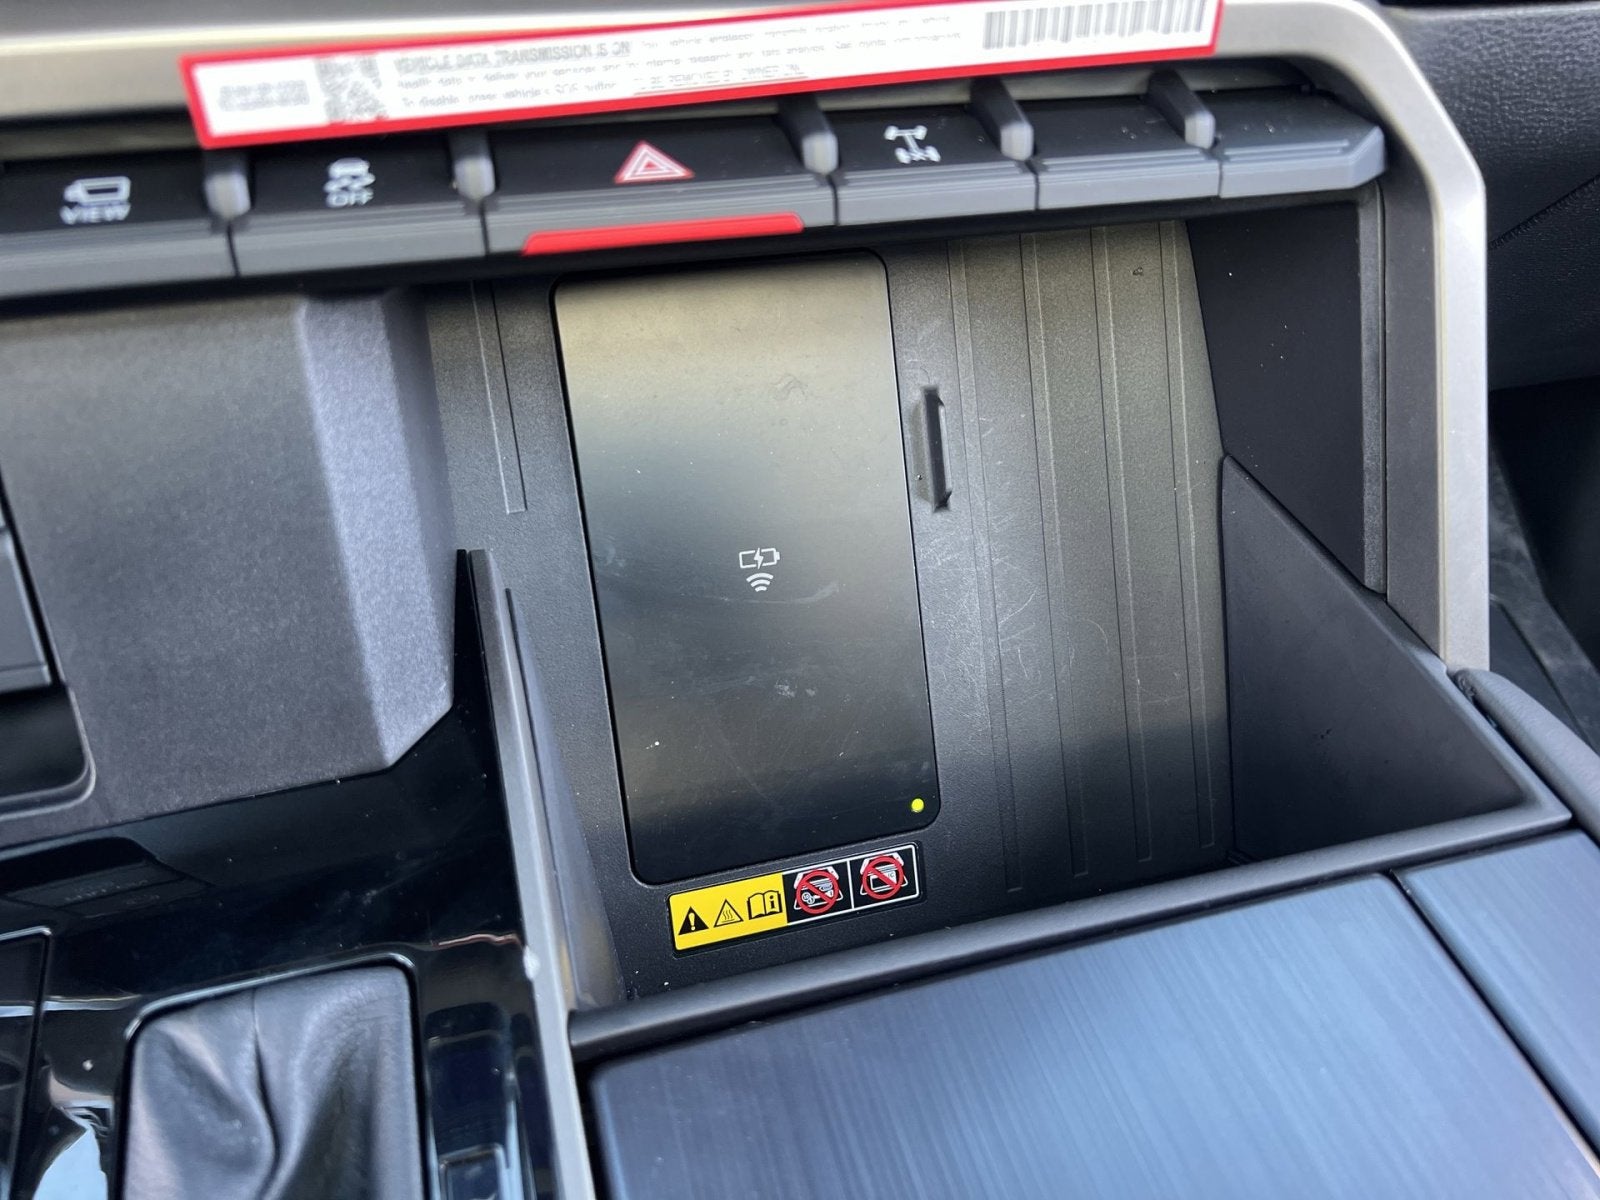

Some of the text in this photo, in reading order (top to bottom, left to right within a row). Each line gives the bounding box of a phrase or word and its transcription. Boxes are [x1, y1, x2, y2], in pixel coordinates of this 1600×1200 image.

[494, 44, 592, 65] TRANSMISSION
[326, 190, 374, 208] OFF
[60, 202, 131, 224] VIEW
